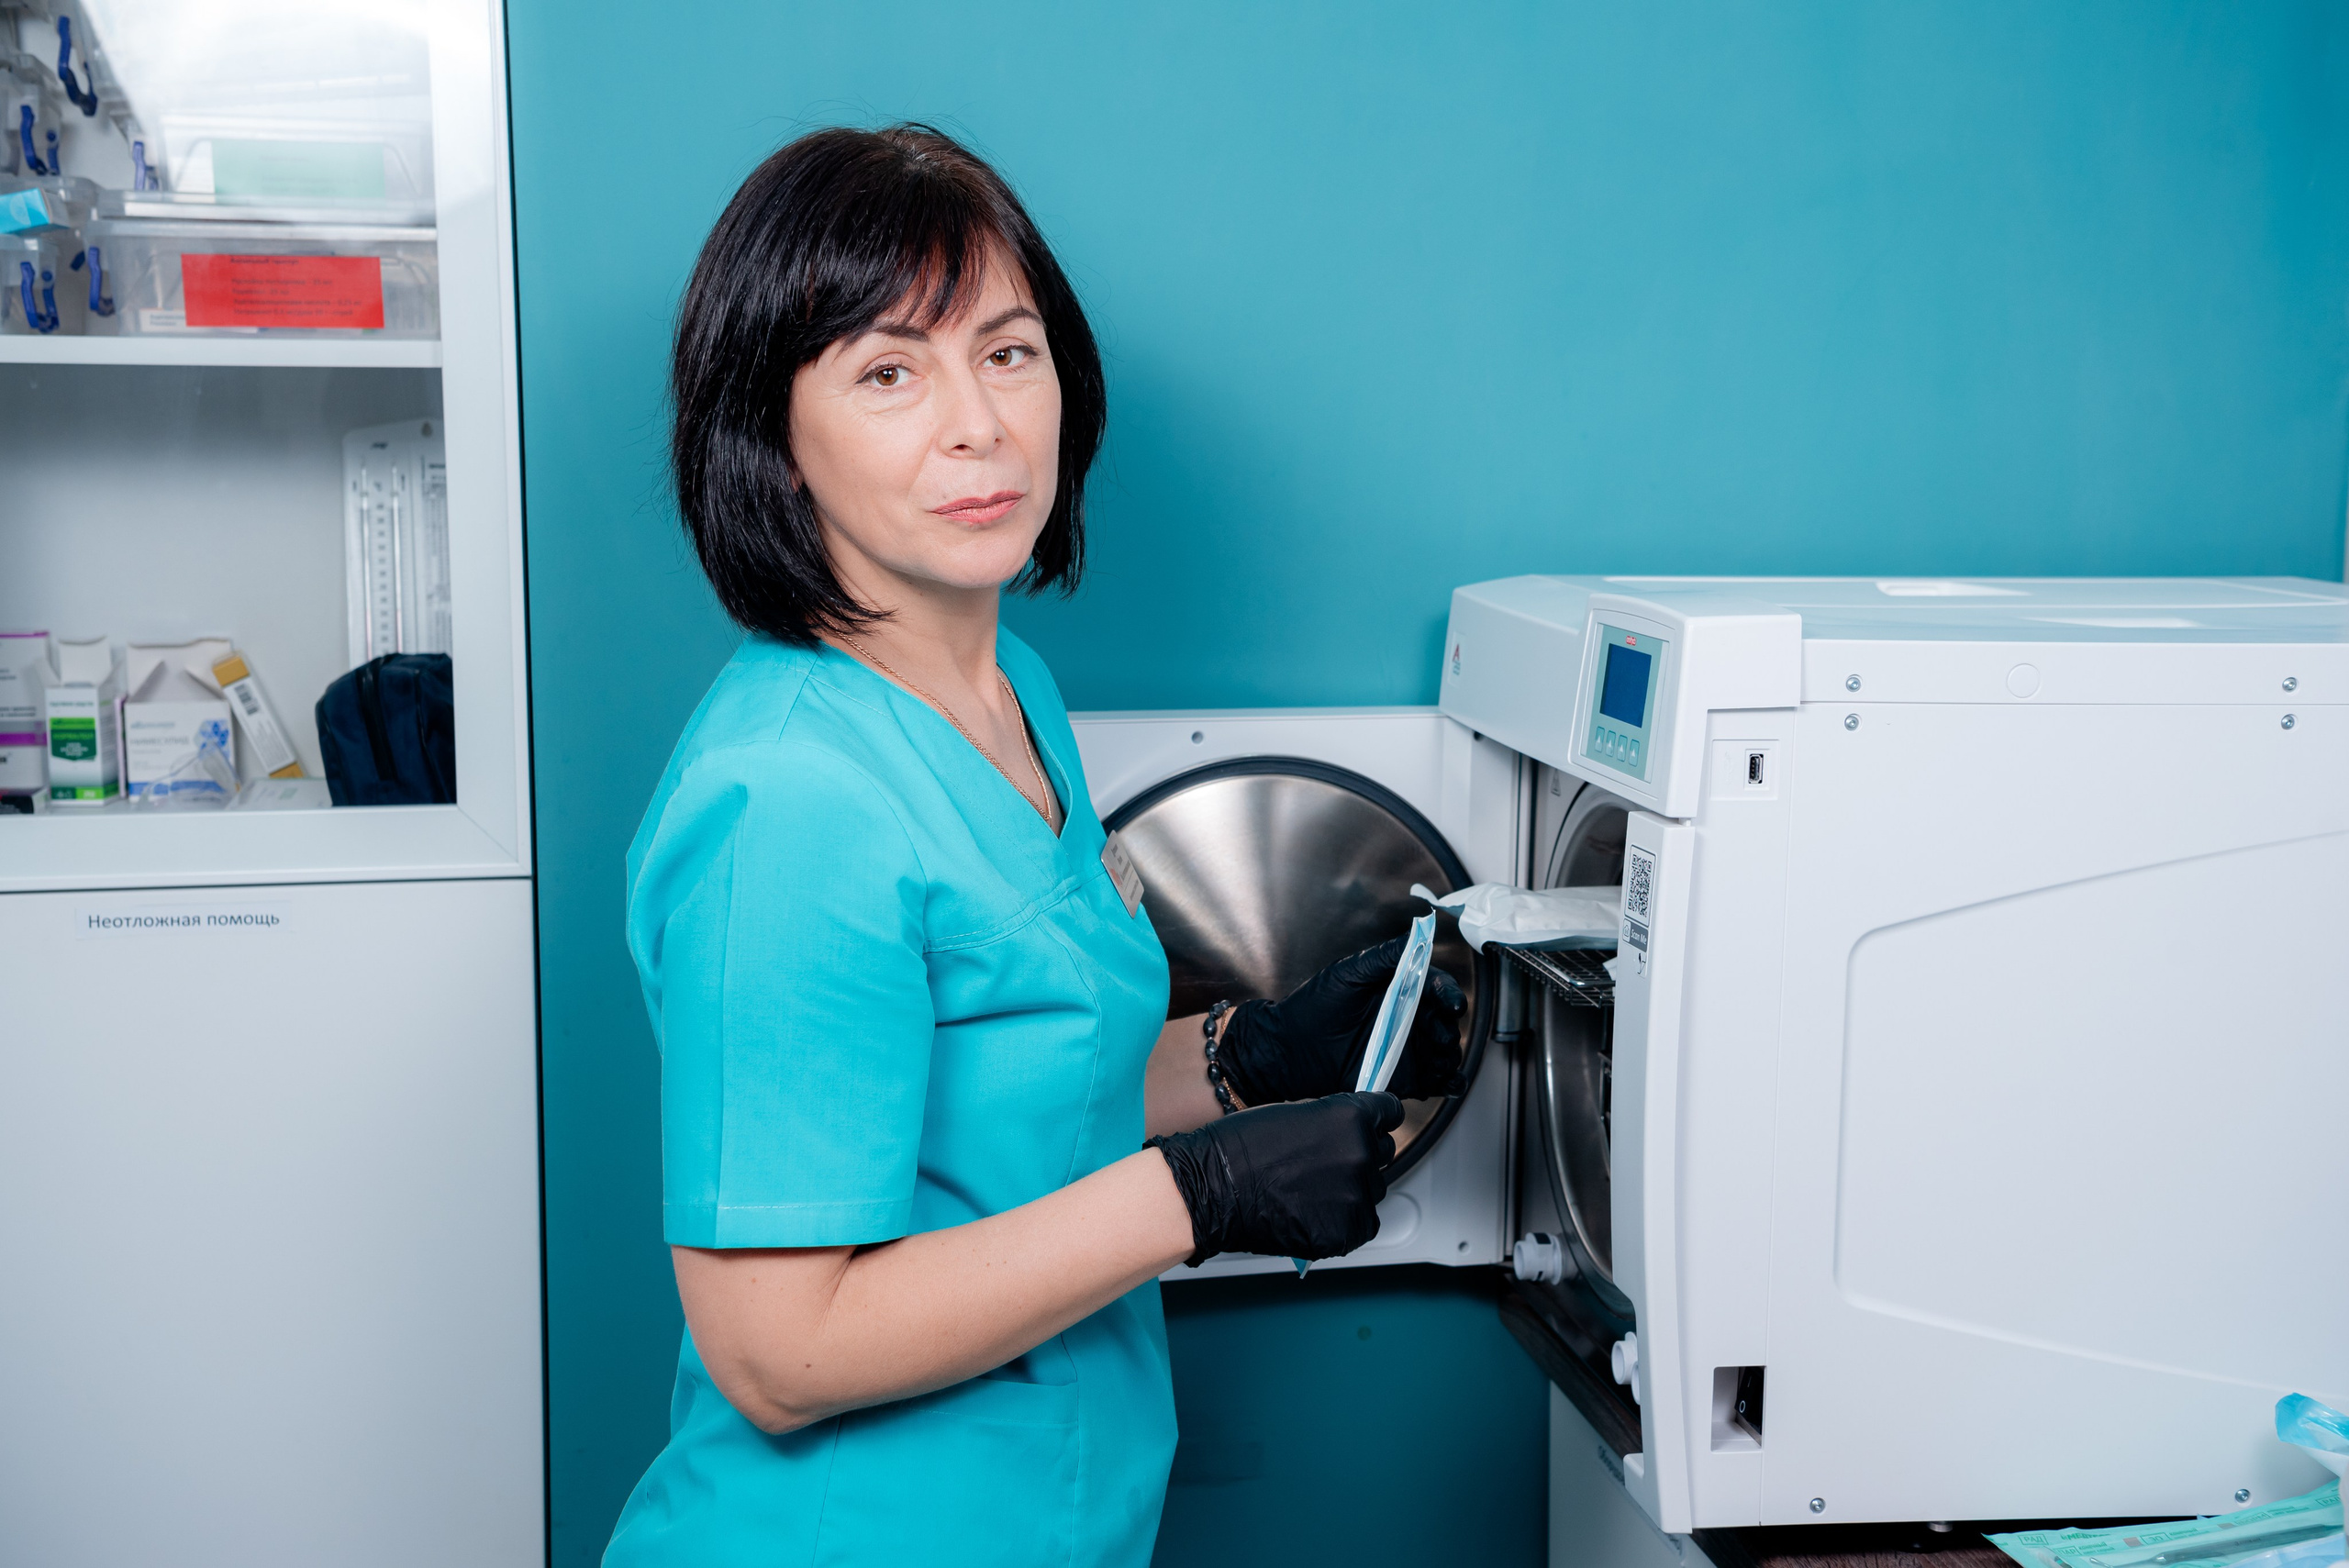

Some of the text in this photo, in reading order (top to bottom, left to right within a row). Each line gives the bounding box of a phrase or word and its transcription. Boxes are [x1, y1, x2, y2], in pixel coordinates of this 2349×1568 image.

[88, 913, 280, 929] Неотложная помощь
[1631, 929, 1647, 945] Scan Me
[2024, 1535, 2044, 1543] РАД
